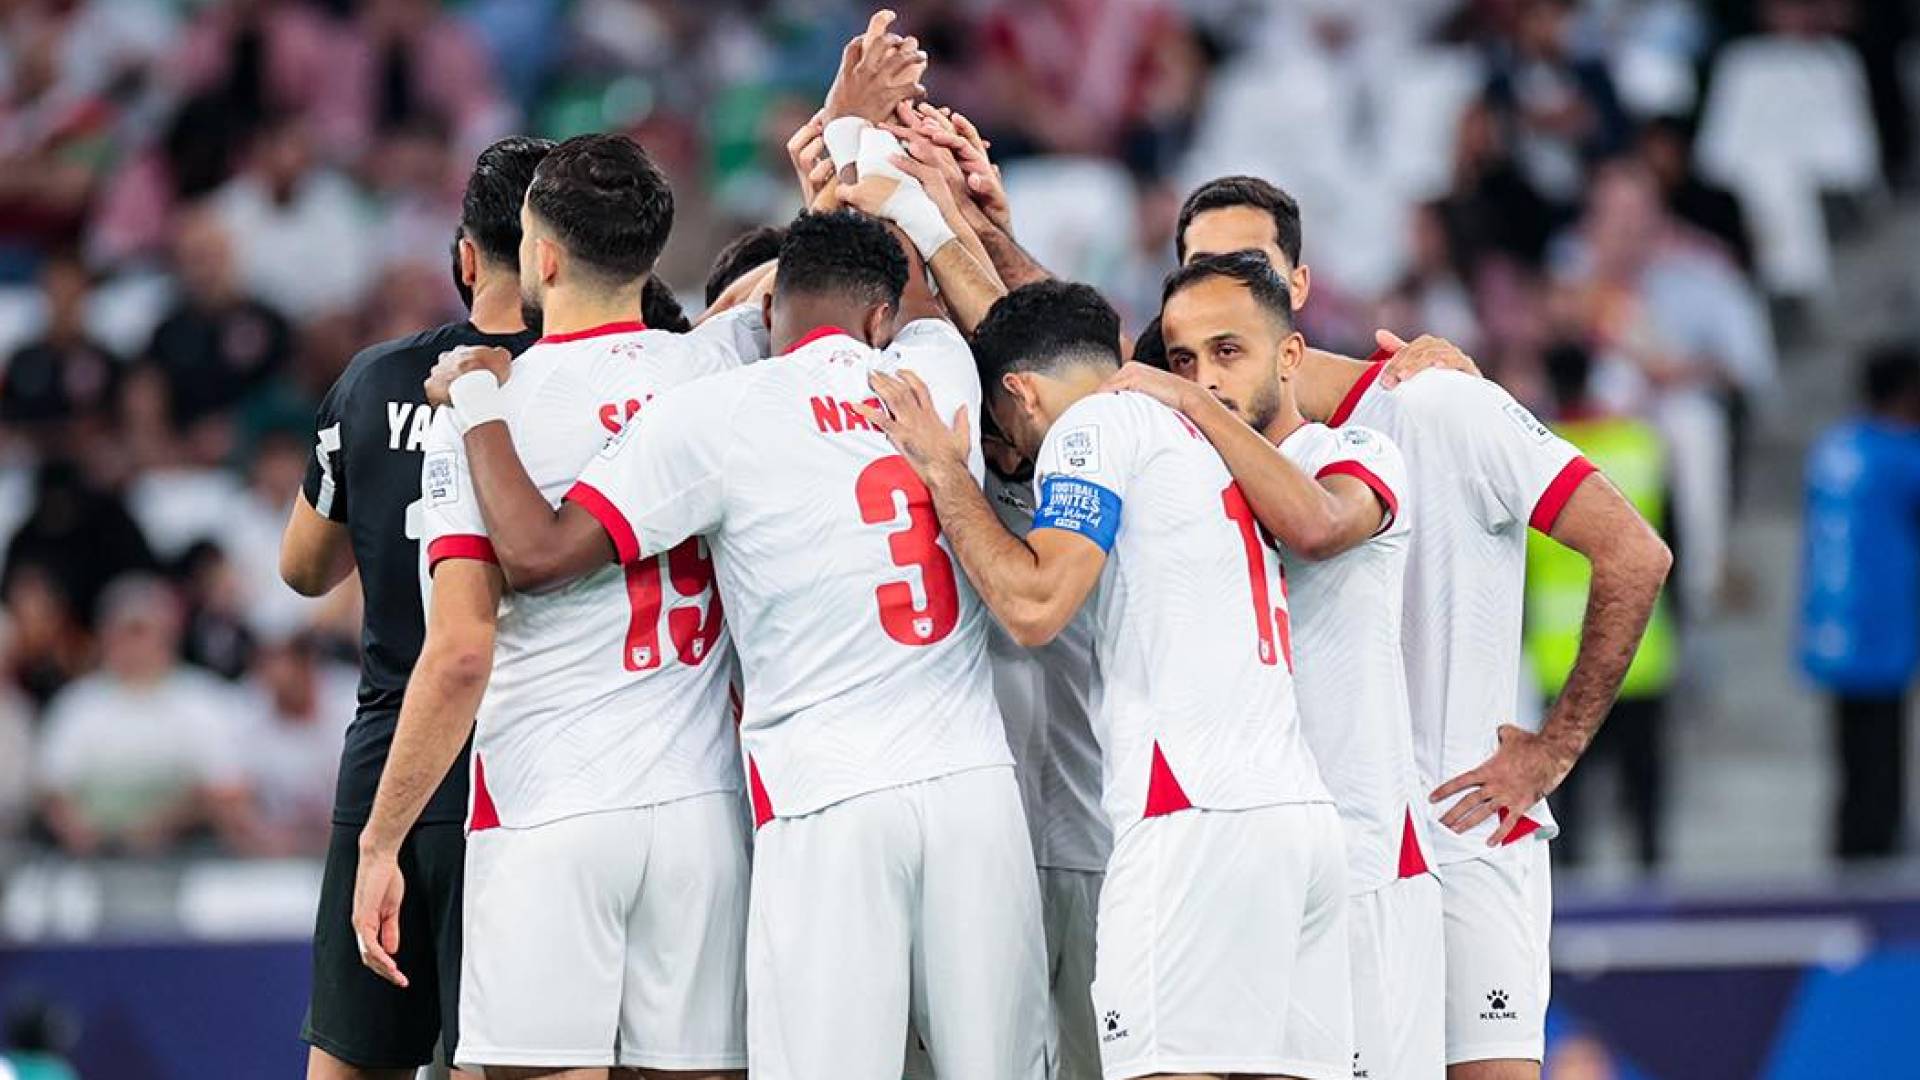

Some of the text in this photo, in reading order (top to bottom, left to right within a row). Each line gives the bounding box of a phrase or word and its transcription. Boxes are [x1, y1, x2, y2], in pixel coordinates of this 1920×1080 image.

[1052, 482, 1099, 498] FOOTBALL
[1050, 494, 1100, 514] UNITES
[855, 454, 960, 645] 3
[1480, 1011, 1518, 1020] KELME
